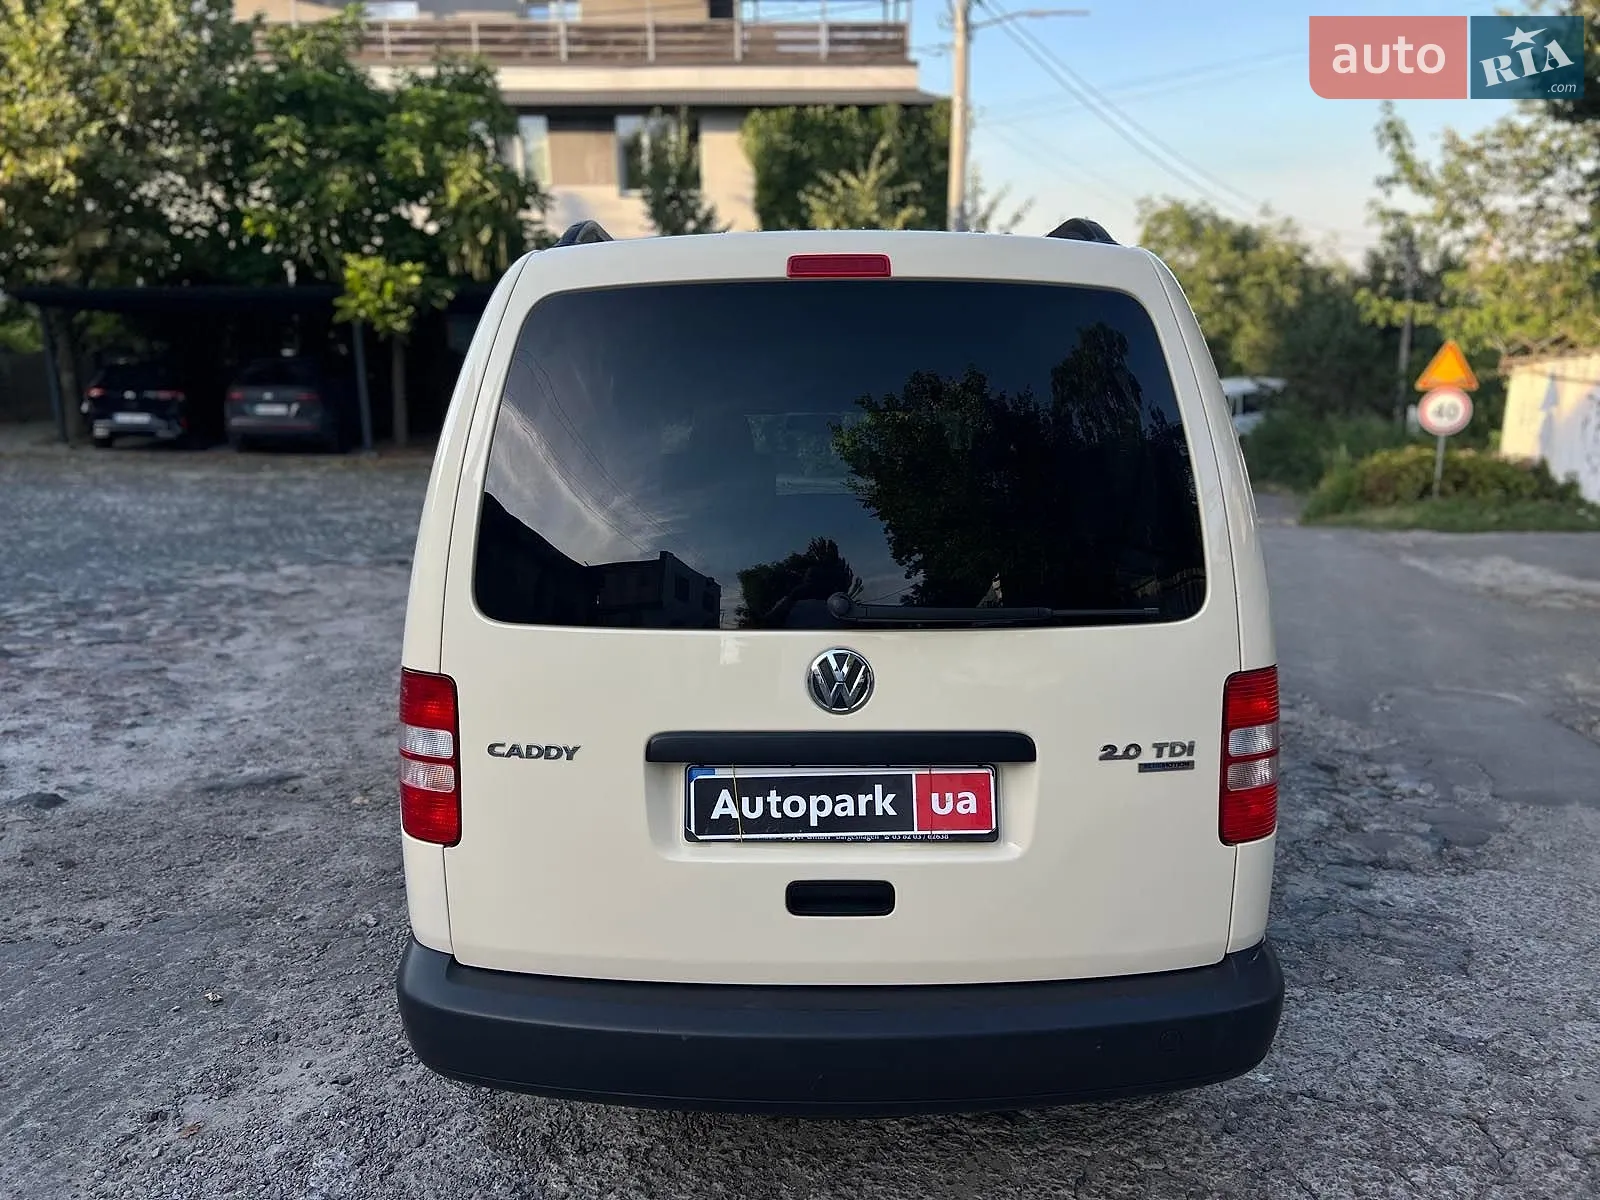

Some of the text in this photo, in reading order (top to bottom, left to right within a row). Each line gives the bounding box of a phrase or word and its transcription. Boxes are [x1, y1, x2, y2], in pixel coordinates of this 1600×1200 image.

[1431, 401, 1461, 421] 40
[487, 742, 581, 760] CADDY
[1099, 740, 1195, 761] 2.0 TDI
[710, 784, 977, 826] Autopark ua
